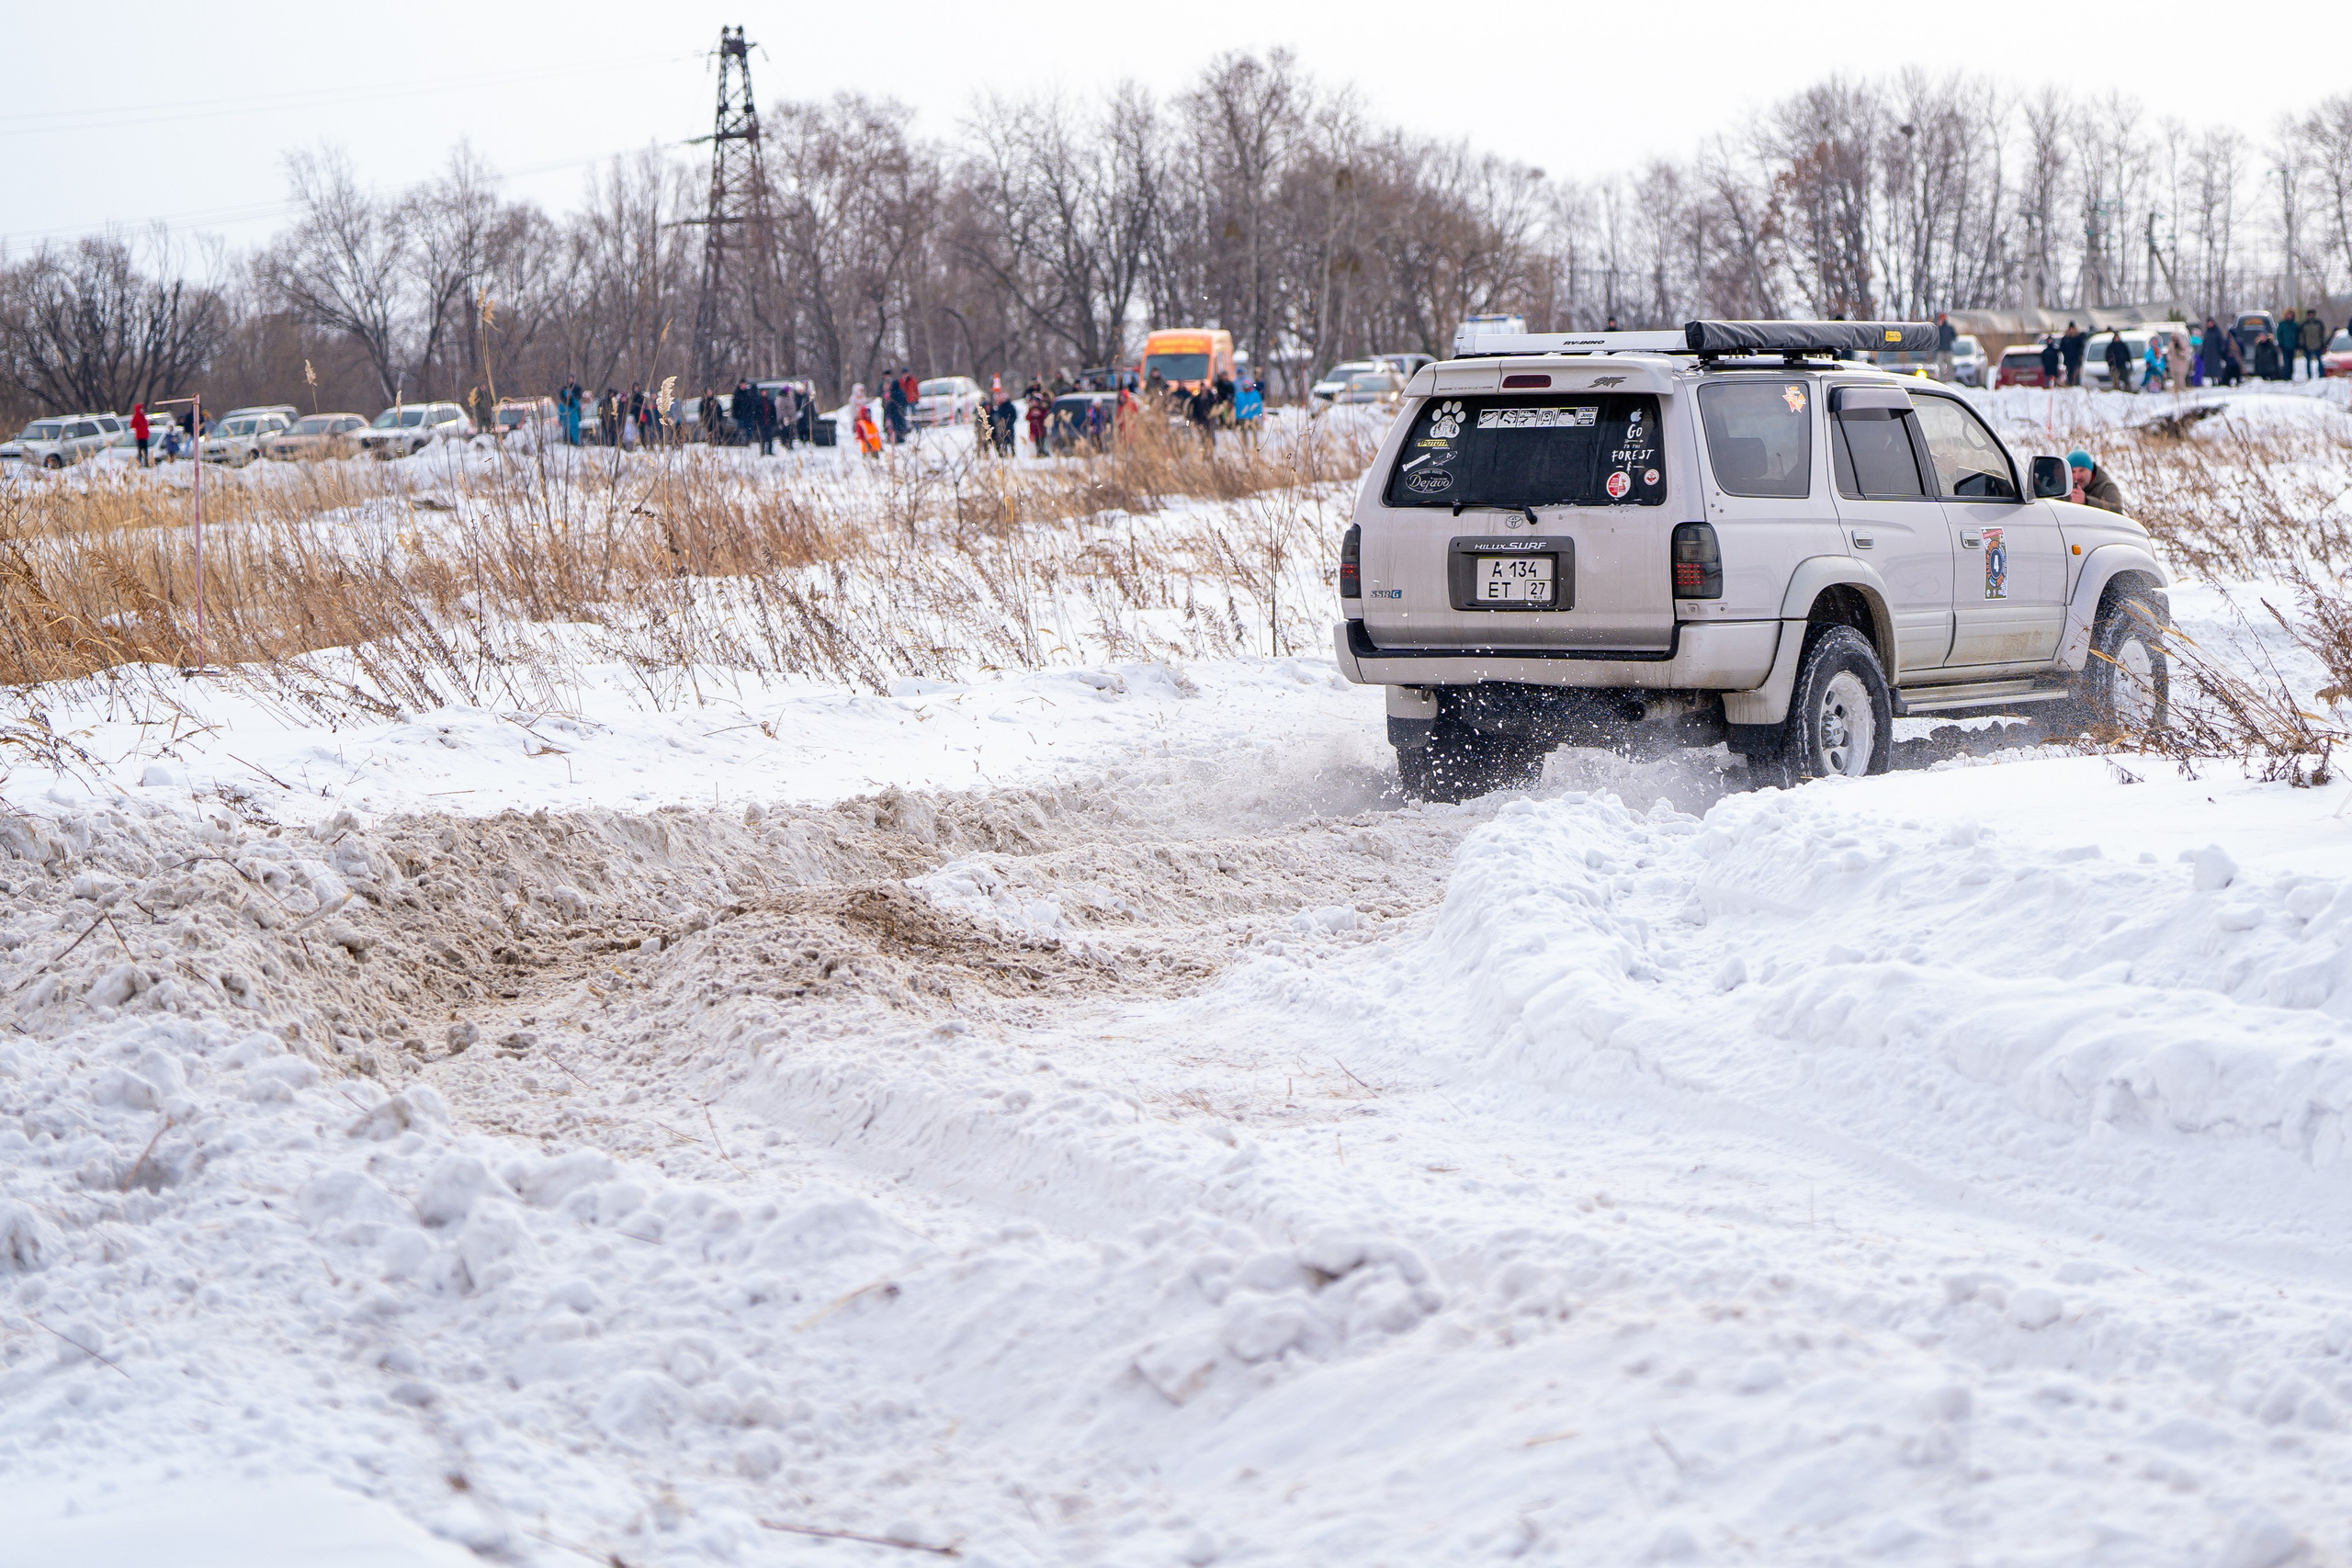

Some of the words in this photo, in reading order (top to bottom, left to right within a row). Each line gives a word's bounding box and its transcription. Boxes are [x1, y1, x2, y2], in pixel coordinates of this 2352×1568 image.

[1611, 449, 1655, 462] FOREST
[1507, 542, 1547, 550] SURF
[1491, 561, 1503, 578] A
[1509, 561, 1537, 578] 134
[1993, 554, 2000, 572] 4
[1488, 581, 1511, 598] ET
[1530, 581, 1546, 595] 27
